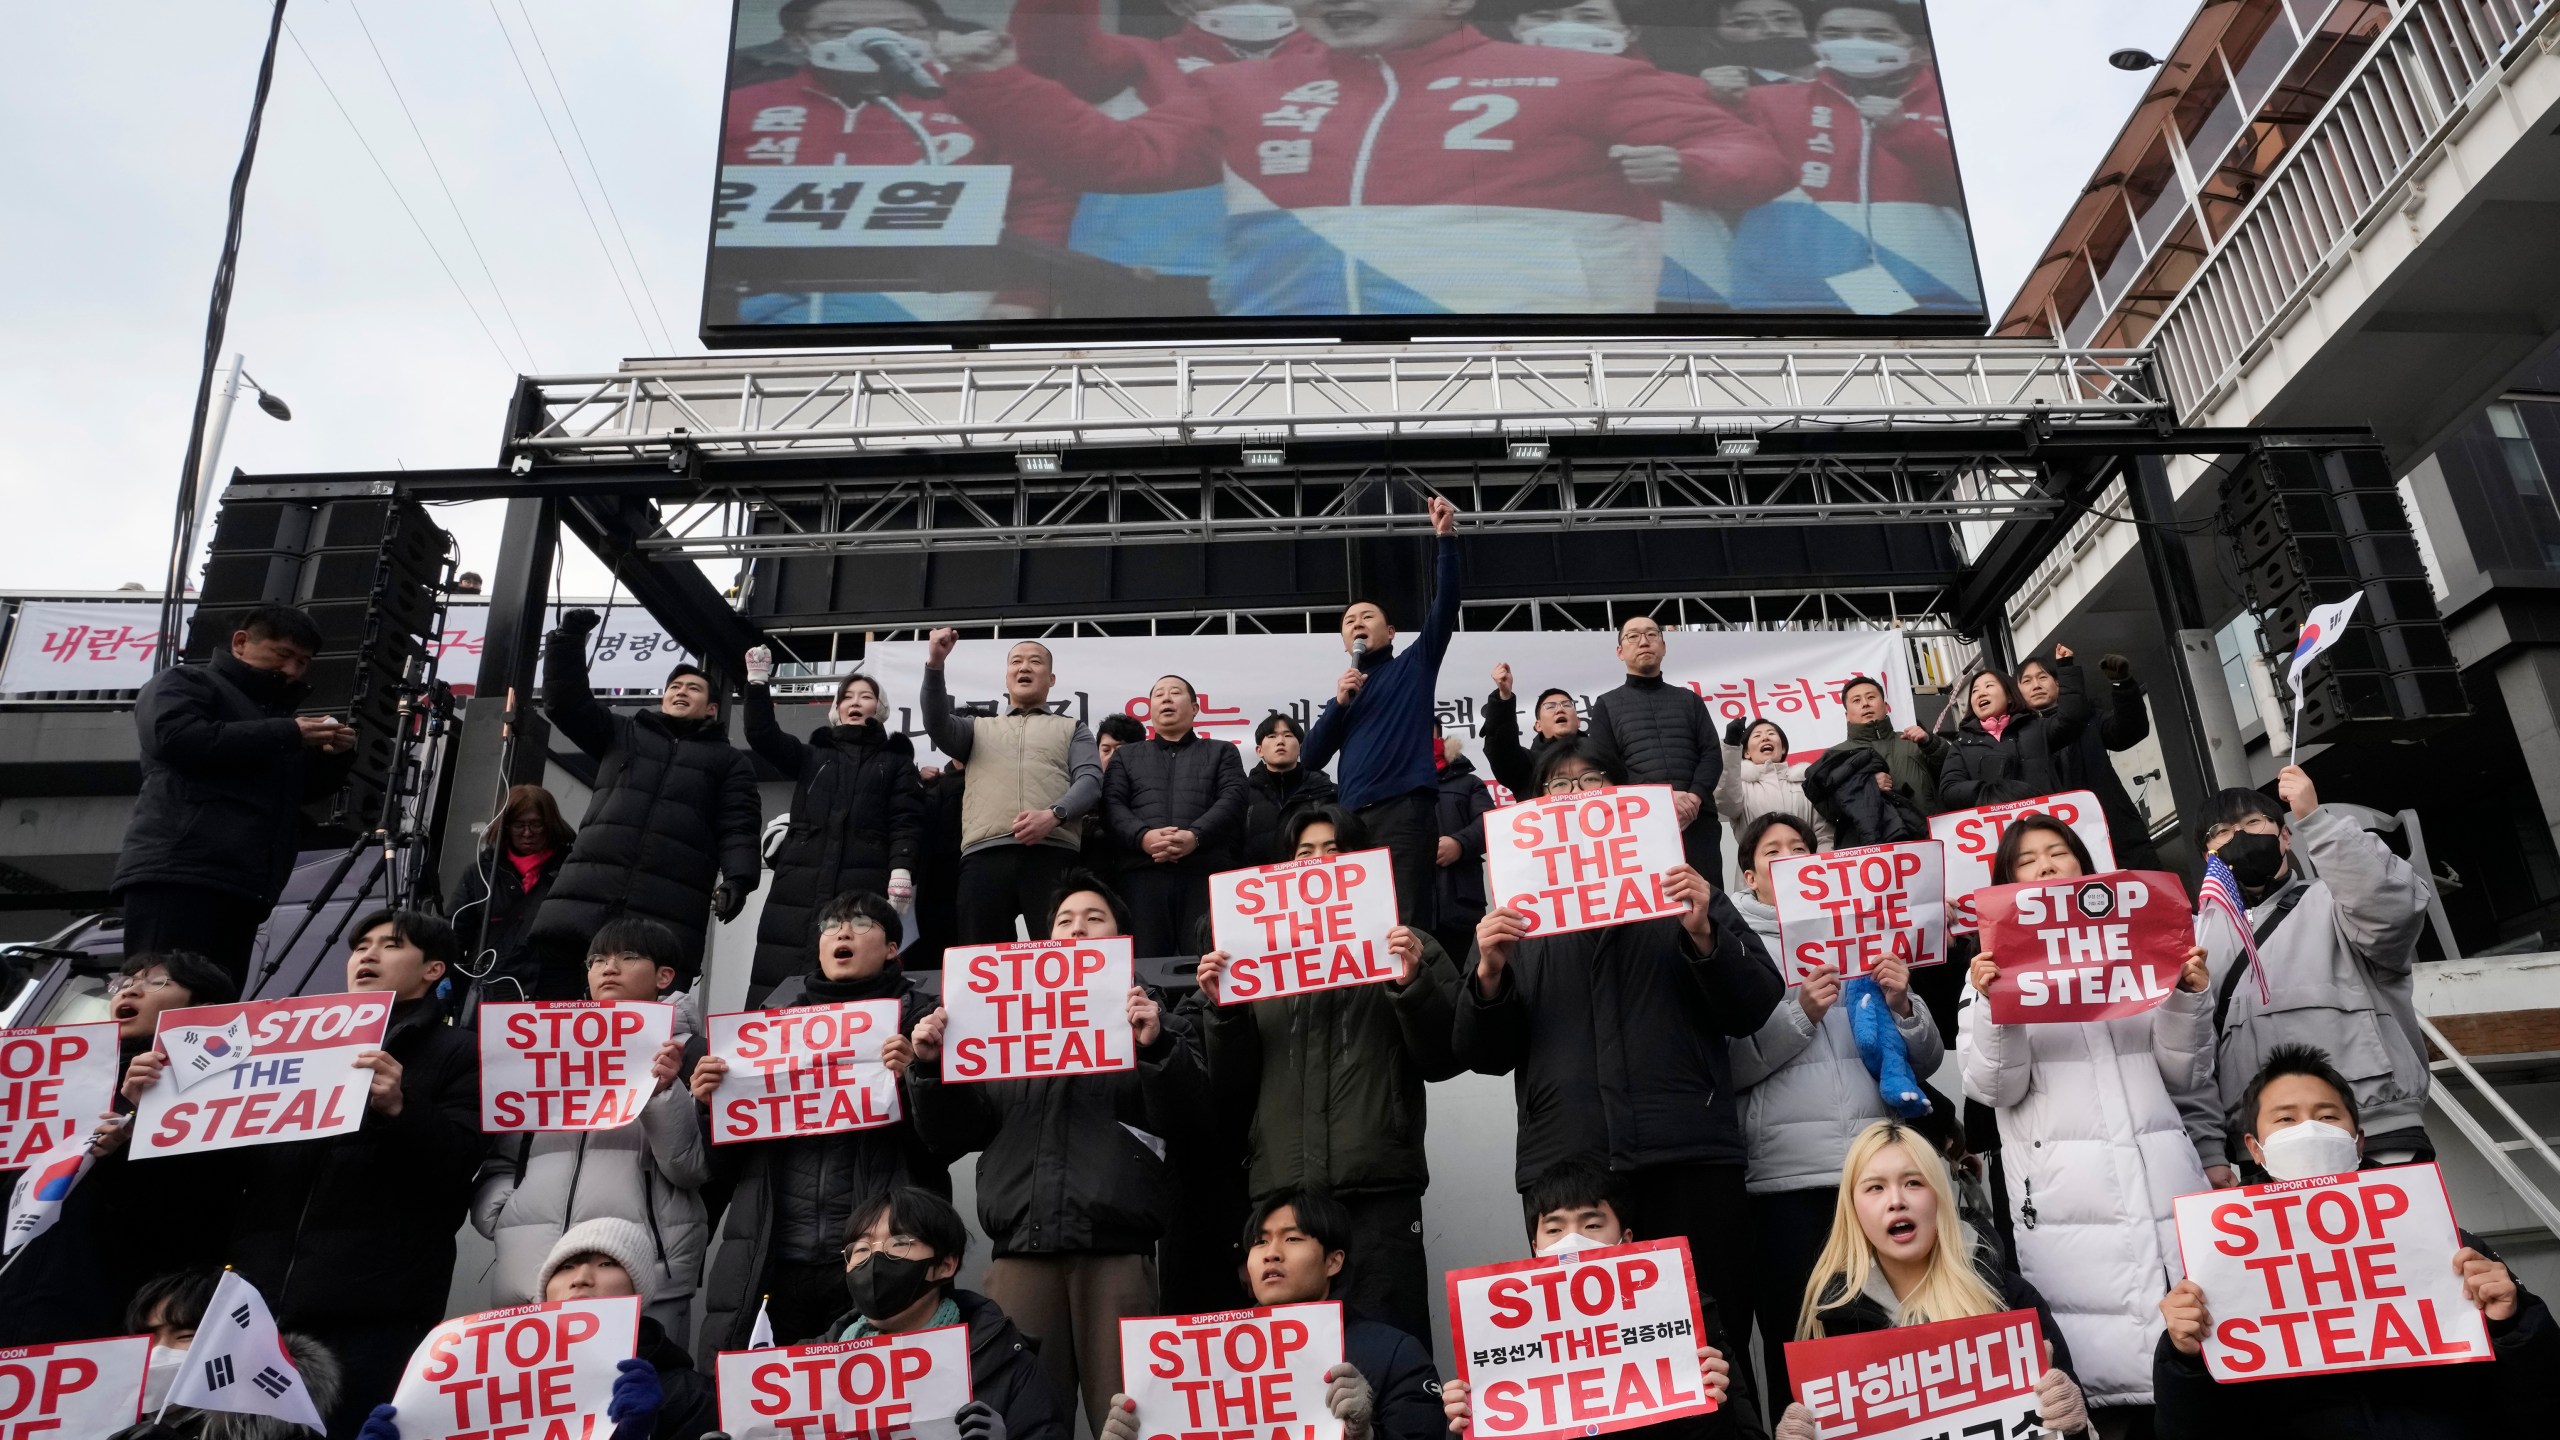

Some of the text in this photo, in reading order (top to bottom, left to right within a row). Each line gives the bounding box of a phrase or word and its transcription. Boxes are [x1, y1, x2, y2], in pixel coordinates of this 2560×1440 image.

[1443, 94, 1520, 150] 2
[42, 615, 174, 663] 내란수
[1551, 793, 1581, 802] SUPPORT
[1991, 799, 2035, 812] SUPPORT YOON
[1513, 796, 1650, 849] STOP
[1956, 804, 2079, 854] STP
[1273, 861, 1304, 871] SUPPORT
[1533, 836, 1643, 886] THE
[1798, 853, 1922, 901] STOP
[1834, 850, 1862, 858] SUPPORT
[1235, 864, 1366, 915] STOP
[1509, 873, 1684, 933] STEAL
[1254, 904, 1356, 952] THE
[1820, 892, 1912, 936] THE
[1010, 940, 1062, 950] SUPPORT YOON
[1796, 928, 1934, 981] STEAL
[2038, 924, 2132, 965] THE
[968, 950, 1105, 993] STOP
[1230, 940, 1392, 997] STEAL
[2016, 964, 2170, 1007] STEAL
[252, 1003, 386, 1047] STOP
[550, 1001, 600, 1009] SUPPORT YOON
[780, 1004, 831, 1016] SUPPORT YOON
[985, 990, 1089, 1033] THE
[12, 1028, 38, 1037] YOON
[506, 1012, 645, 1049] STOP
[737, 1012, 873, 1058] STOP
[955, 1030, 1123, 1076] STEAL
[0, 1036, 89, 1078] OP
[230, 1057, 303, 1090] THE
[524, 1050, 627, 1088] THE
[753, 1050, 856, 1094] THE
[0, 1079, 64, 1121] HE
[151, 1085, 346, 1147] STEAL
[494, 1089, 638, 1128] STEAL
[726, 1087, 889, 1137] STEAL
[2263, 1175, 2338, 1193] SUPPORT YOON
[2211, 1184, 2408, 1256] STOP
[1488, 1258, 1659, 1329] STOP
[2244, 1243, 2406, 1309] THE
[479, 1304, 542, 1321] SUPPORT YOON
[1191, 1310, 1254, 1325] SUPPORT YOON
[2217, 1299, 2471, 1372] STEAL
[422, 1312, 600, 1382] STOP
[805, 1338, 873, 1355] SUPPORT YOON
[1149, 1320, 1309, 1379] STOP
[1473, 1319, 1692, 1367] 부정선거 THE 검증하라
[0, 1357, 98, 1420] OP
[439, 1365, 576, 1430] THE
[750, 1347, 932, 1416] STOP
[1173, 1373, 1297, 1428] THE
[1483, 1358, 1696, 1432] STEAL
[1801, 1321, 2042, 1439] 탄핵반대
